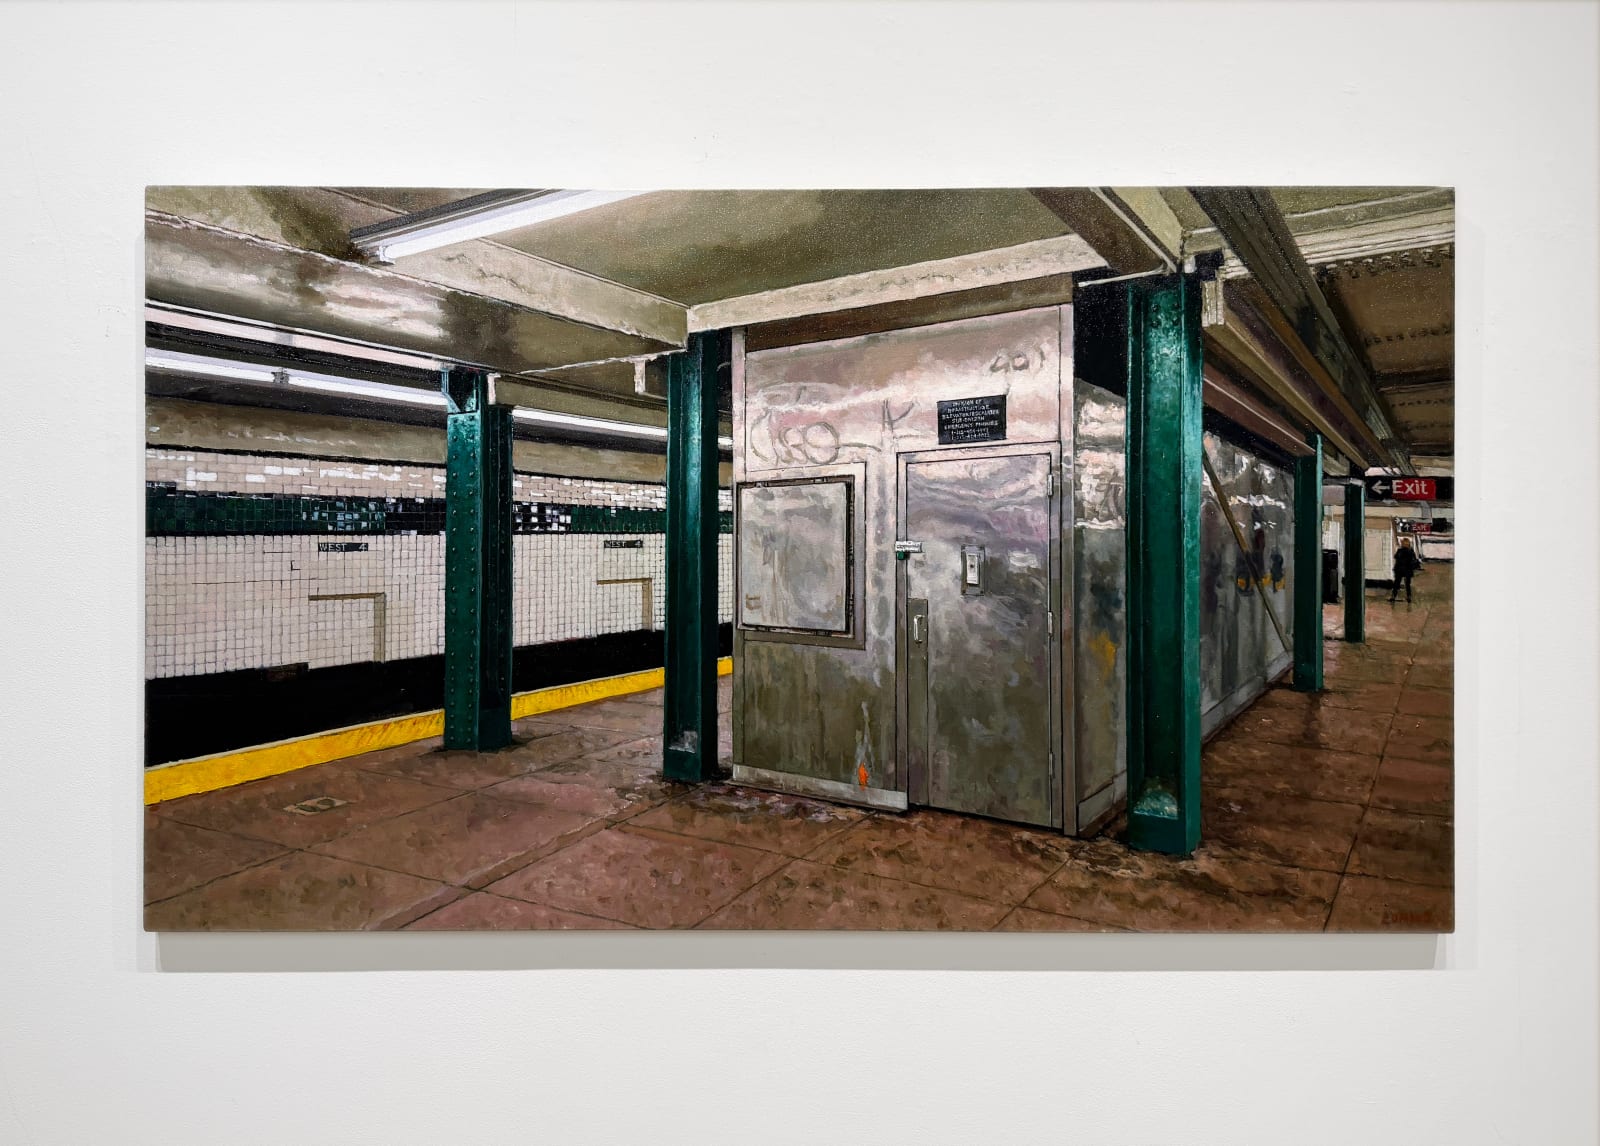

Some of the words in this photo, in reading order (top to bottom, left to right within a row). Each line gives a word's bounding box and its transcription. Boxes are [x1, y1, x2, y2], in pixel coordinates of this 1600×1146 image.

[1392, 480, 1428, 495] Exit
[319, 543, 348, 551] WEST
[358, 543, 367, 551] 4
